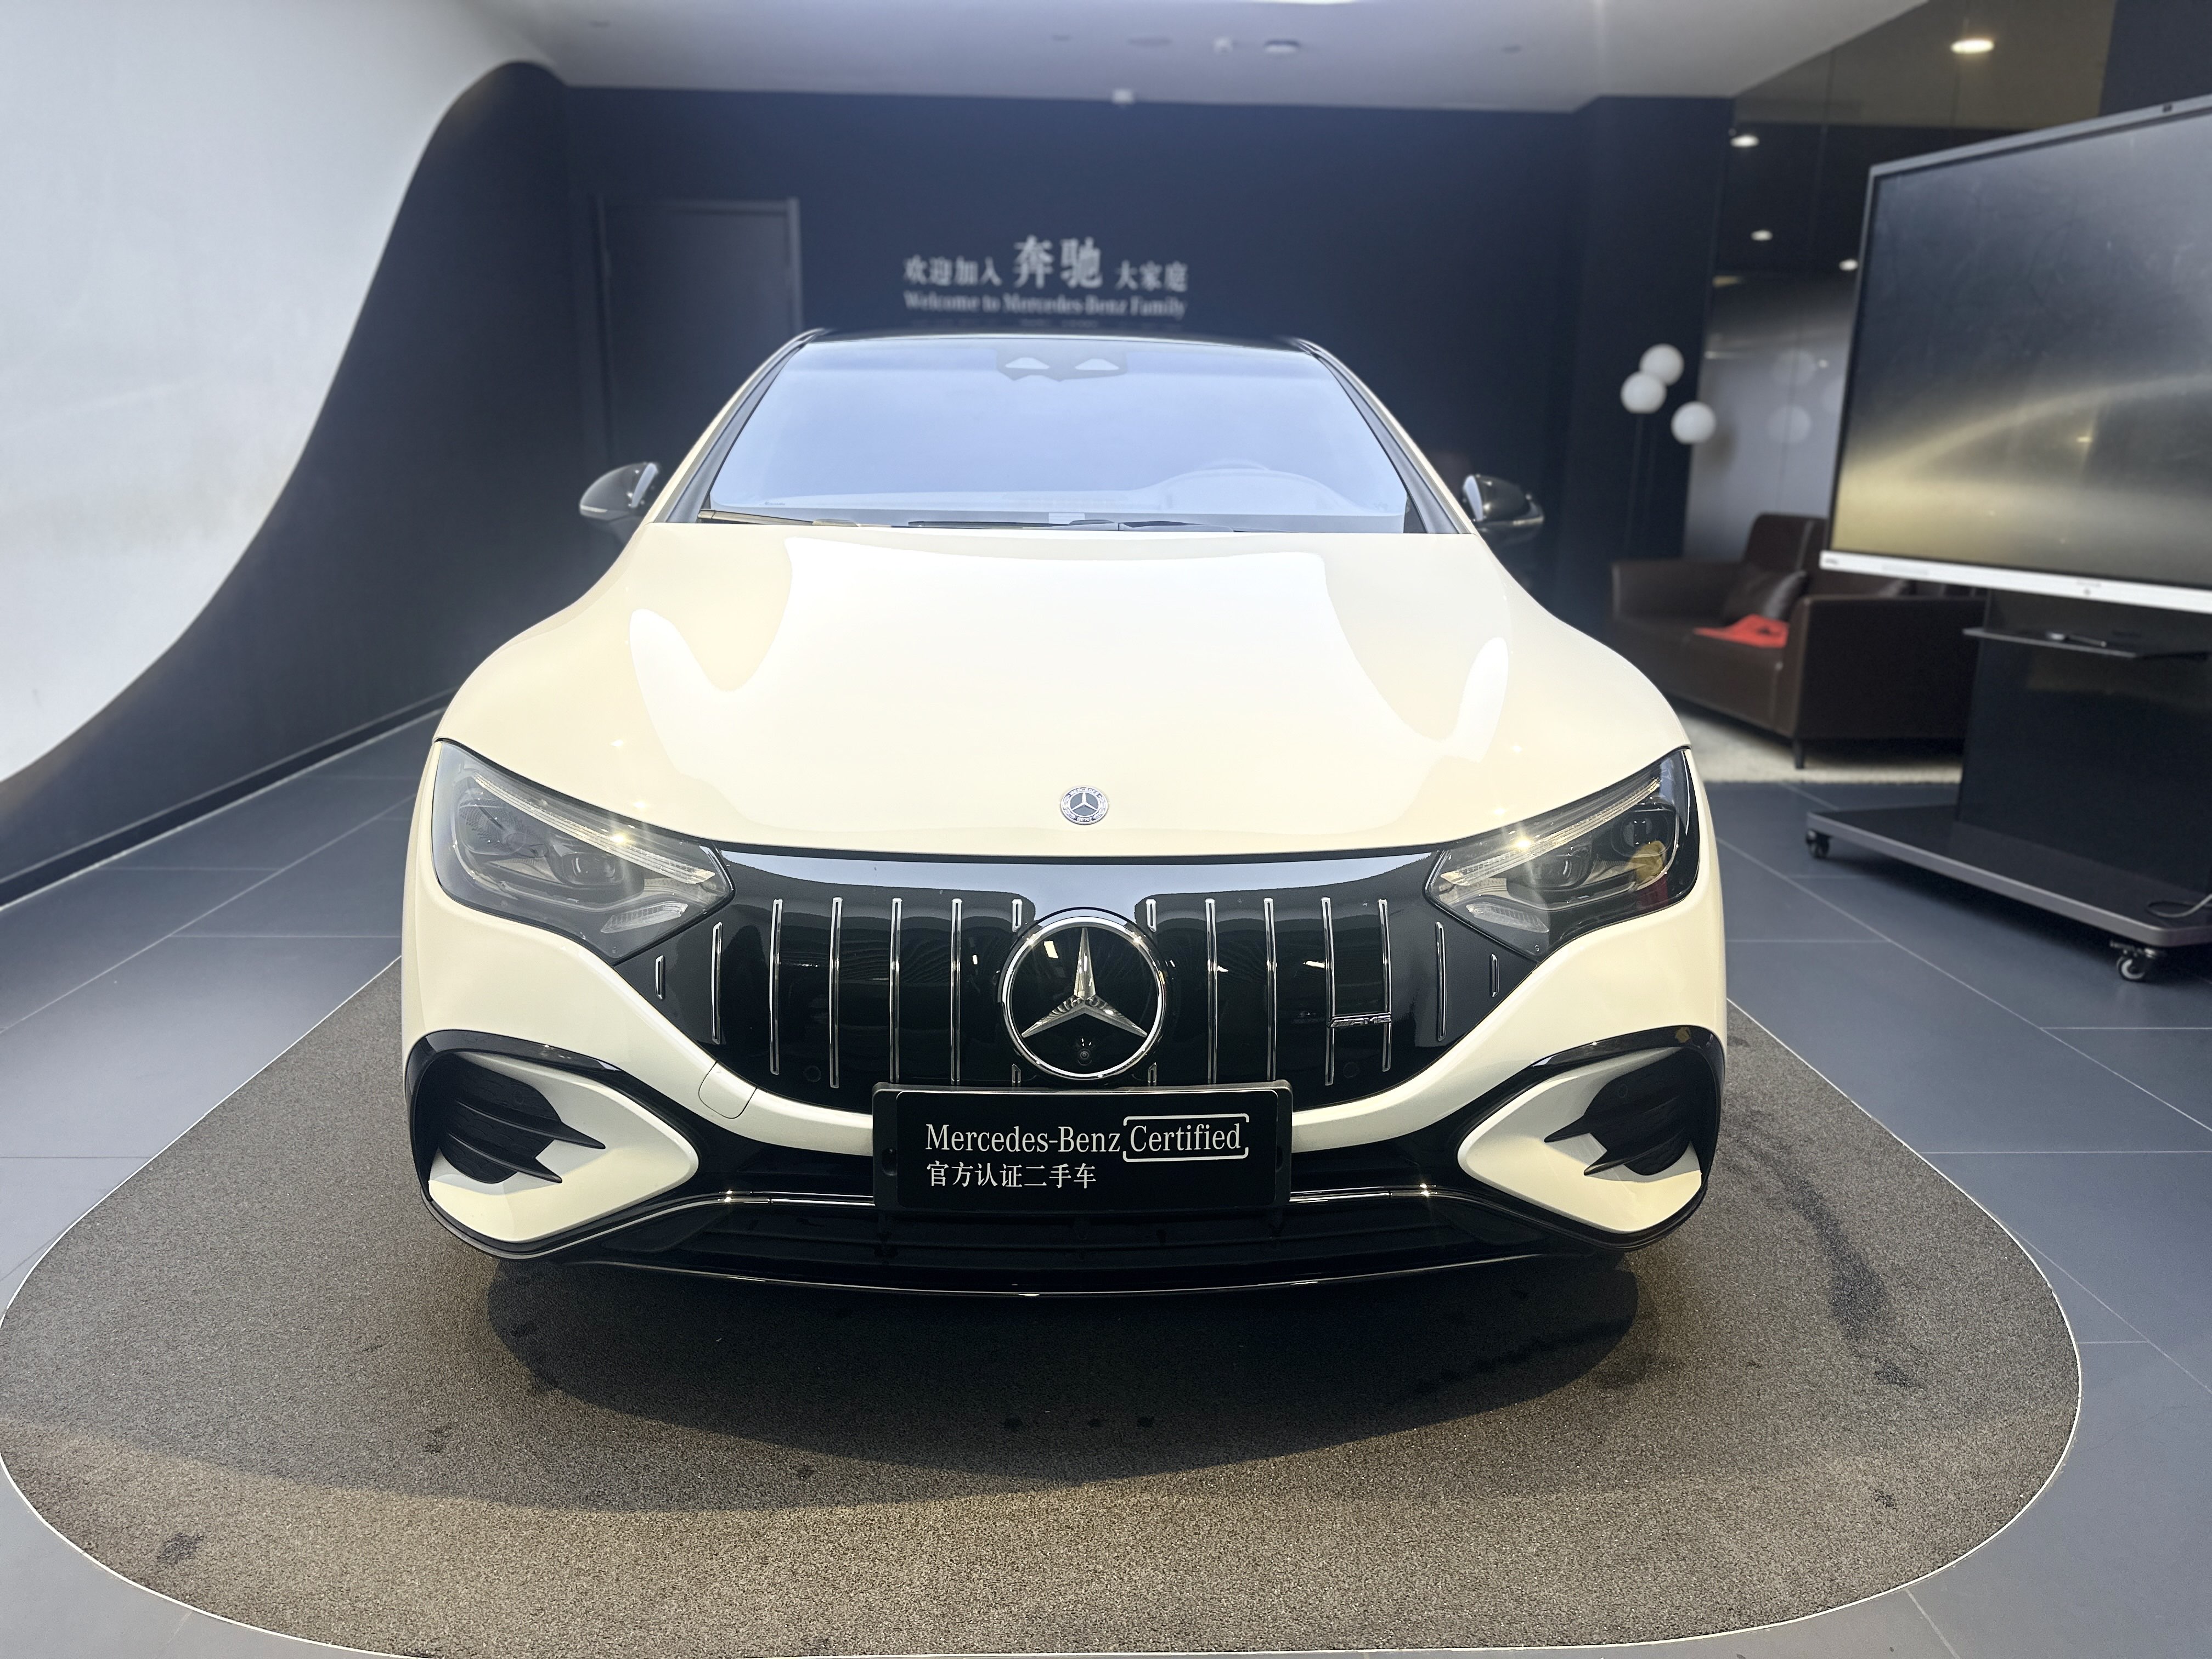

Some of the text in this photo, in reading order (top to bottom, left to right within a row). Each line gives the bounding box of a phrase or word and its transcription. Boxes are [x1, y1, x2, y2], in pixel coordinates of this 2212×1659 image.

[905, 235, 1187, 292] 欢迎加入 奔驰 大家庭
[904, 291, 980, 311] Welcome
[982, 296, 1001, 311] to
[1130, 296, 1186, 318] Family
[926, 1122, 1241, 1153] Mercedes-Benz Certified
[927, 1160, 1097, 1189] 官方认证二手车
